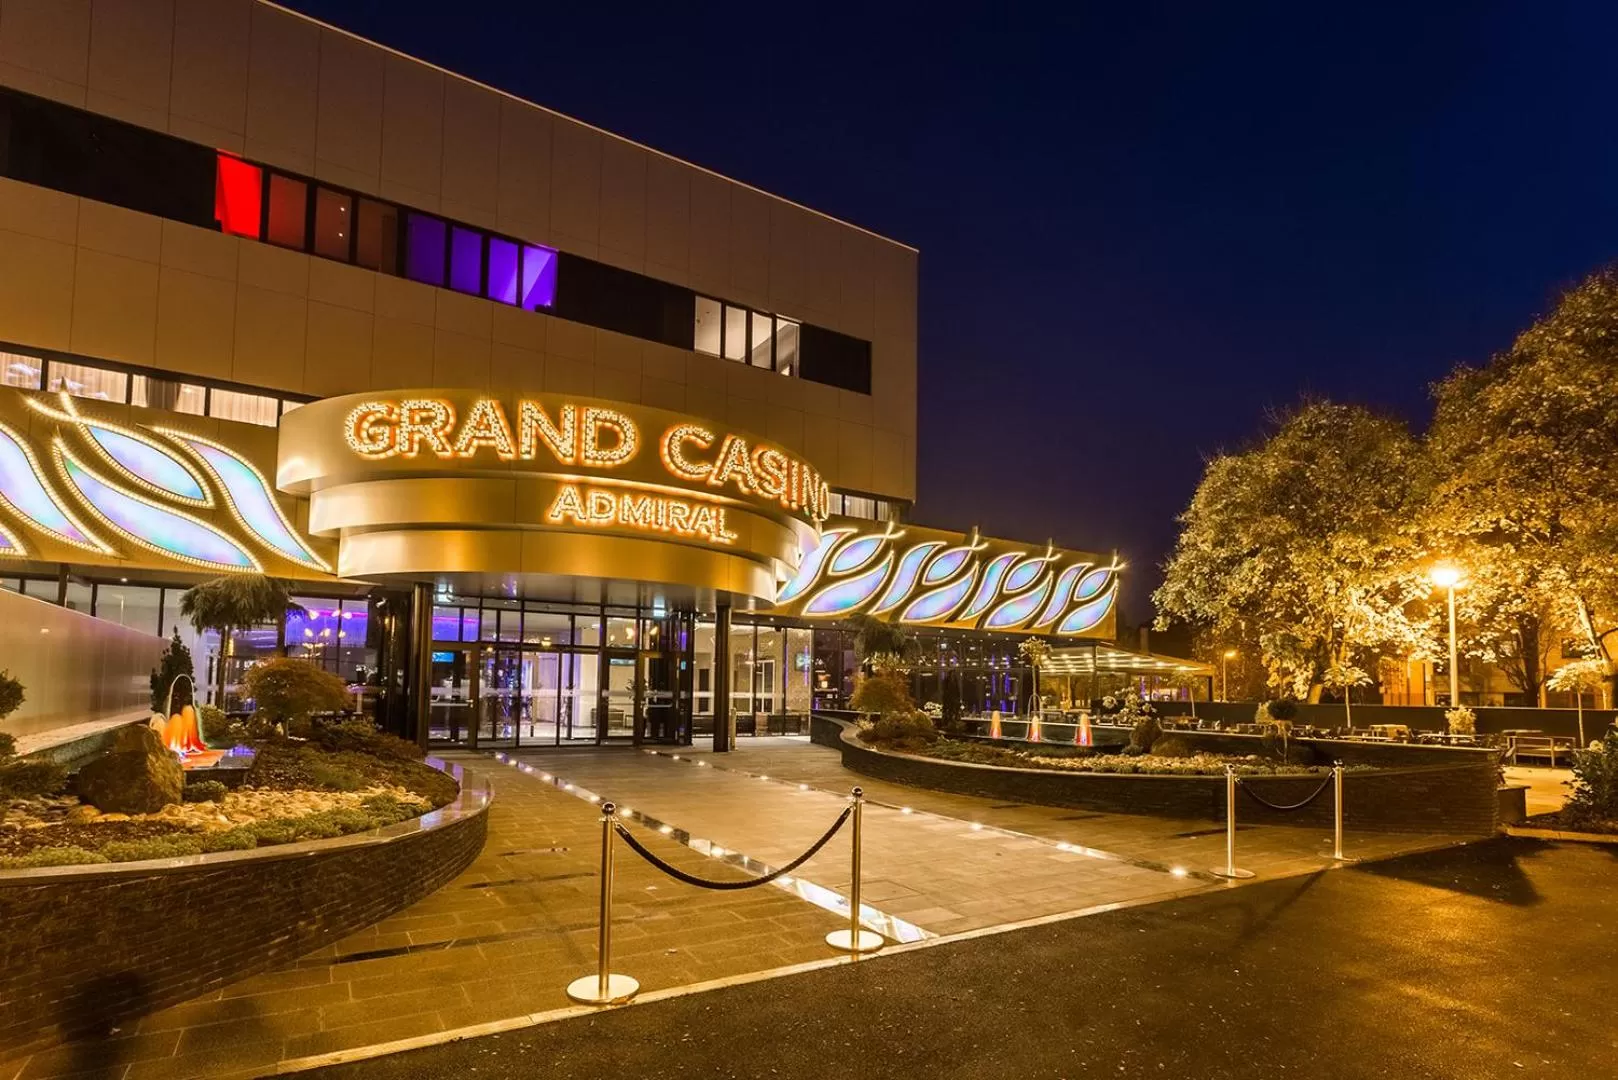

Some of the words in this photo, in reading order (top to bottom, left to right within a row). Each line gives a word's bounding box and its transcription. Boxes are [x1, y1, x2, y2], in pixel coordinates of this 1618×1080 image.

[344, 398, 639, 466] GRAND
[660, 424, 829, 521] CASINO
[547, 484, 738, 545] ADMIRAL
